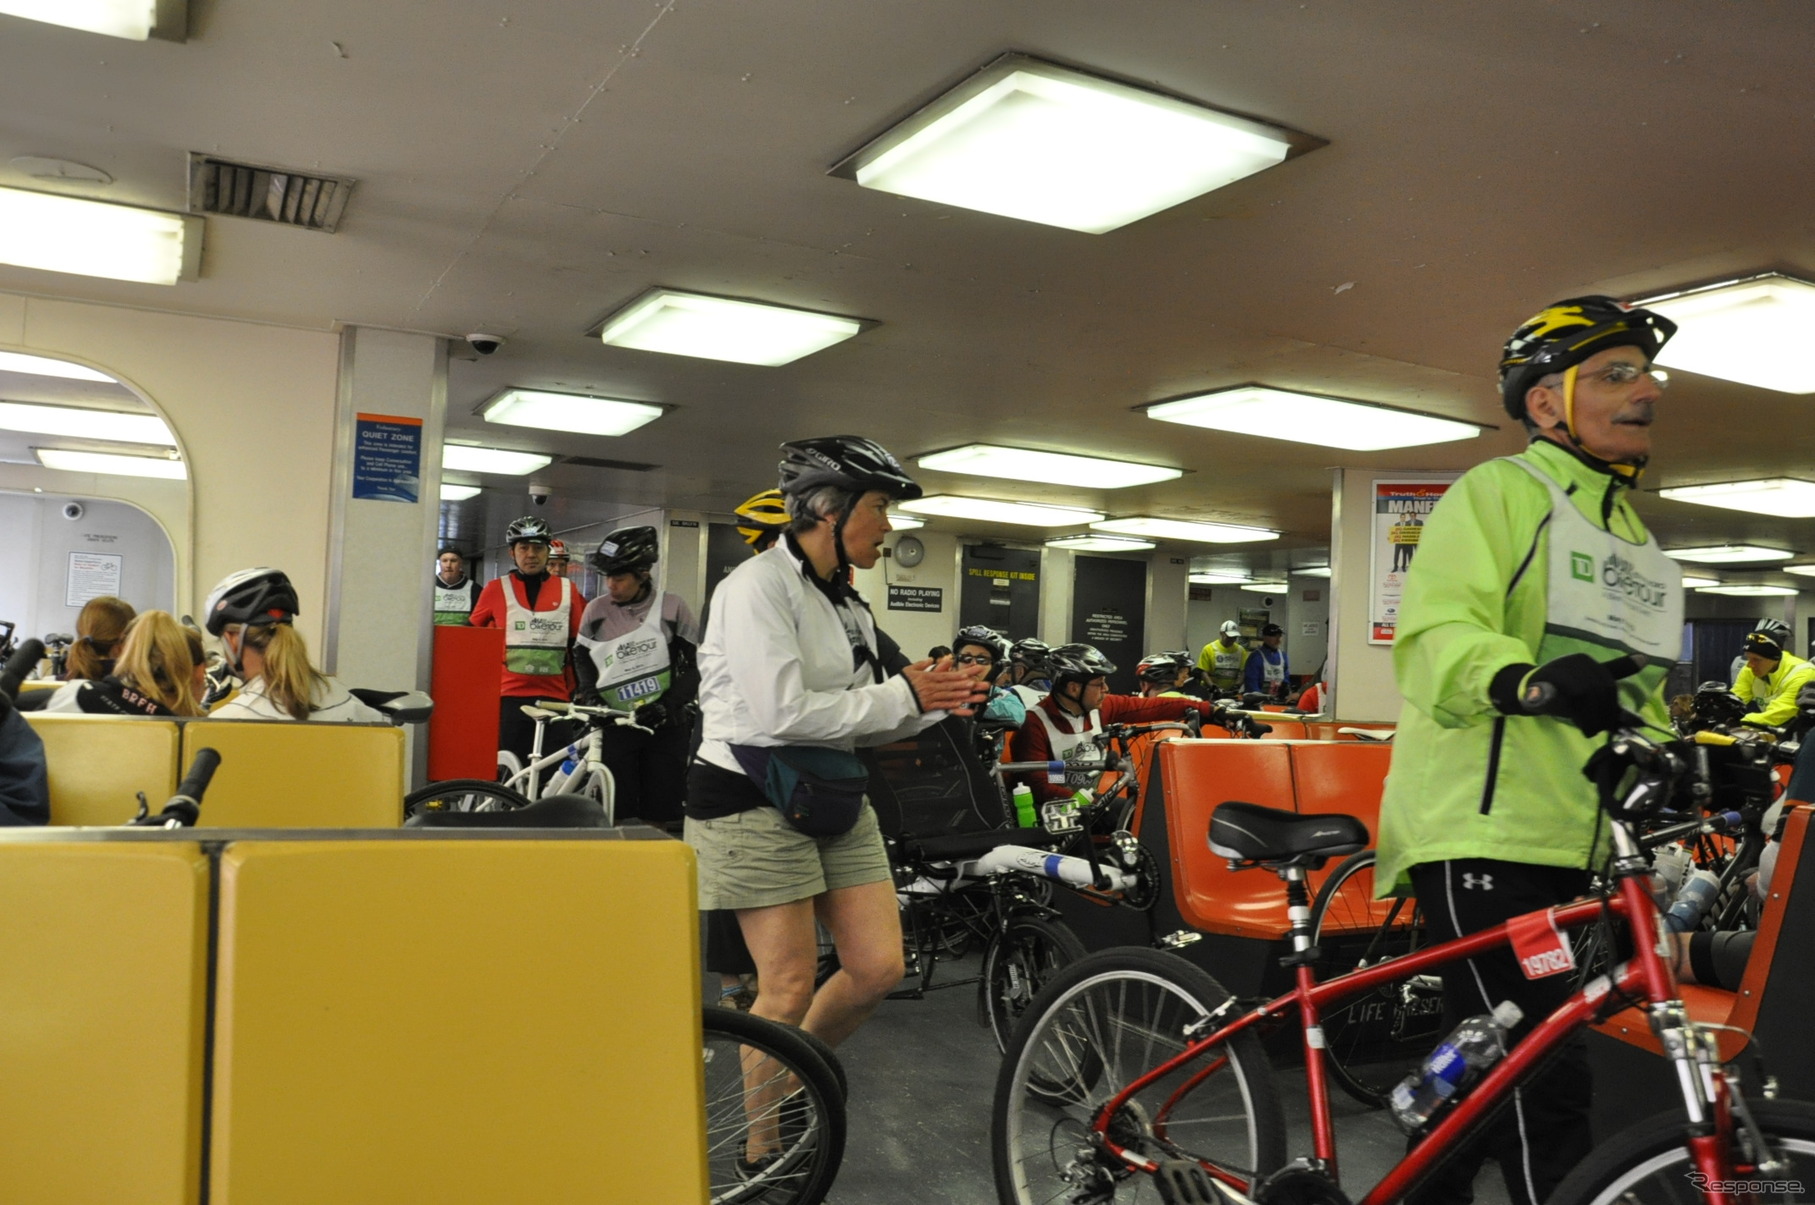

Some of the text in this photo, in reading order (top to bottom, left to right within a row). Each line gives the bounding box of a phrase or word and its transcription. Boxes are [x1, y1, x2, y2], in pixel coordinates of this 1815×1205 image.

[362, 431, 414, 442] QUIET ZONE
[815, 453, 841, 471] GIRO
[968, 568, 1035, 581] SPILL RESPONSE KIT INSIDE
[1572, 557, 1591, 578] TD
[619, 678, 657, 700] 11419
[1522, 948, 1569, 976] 19782
[1348, 1003, 1387, 1024] LIFE
